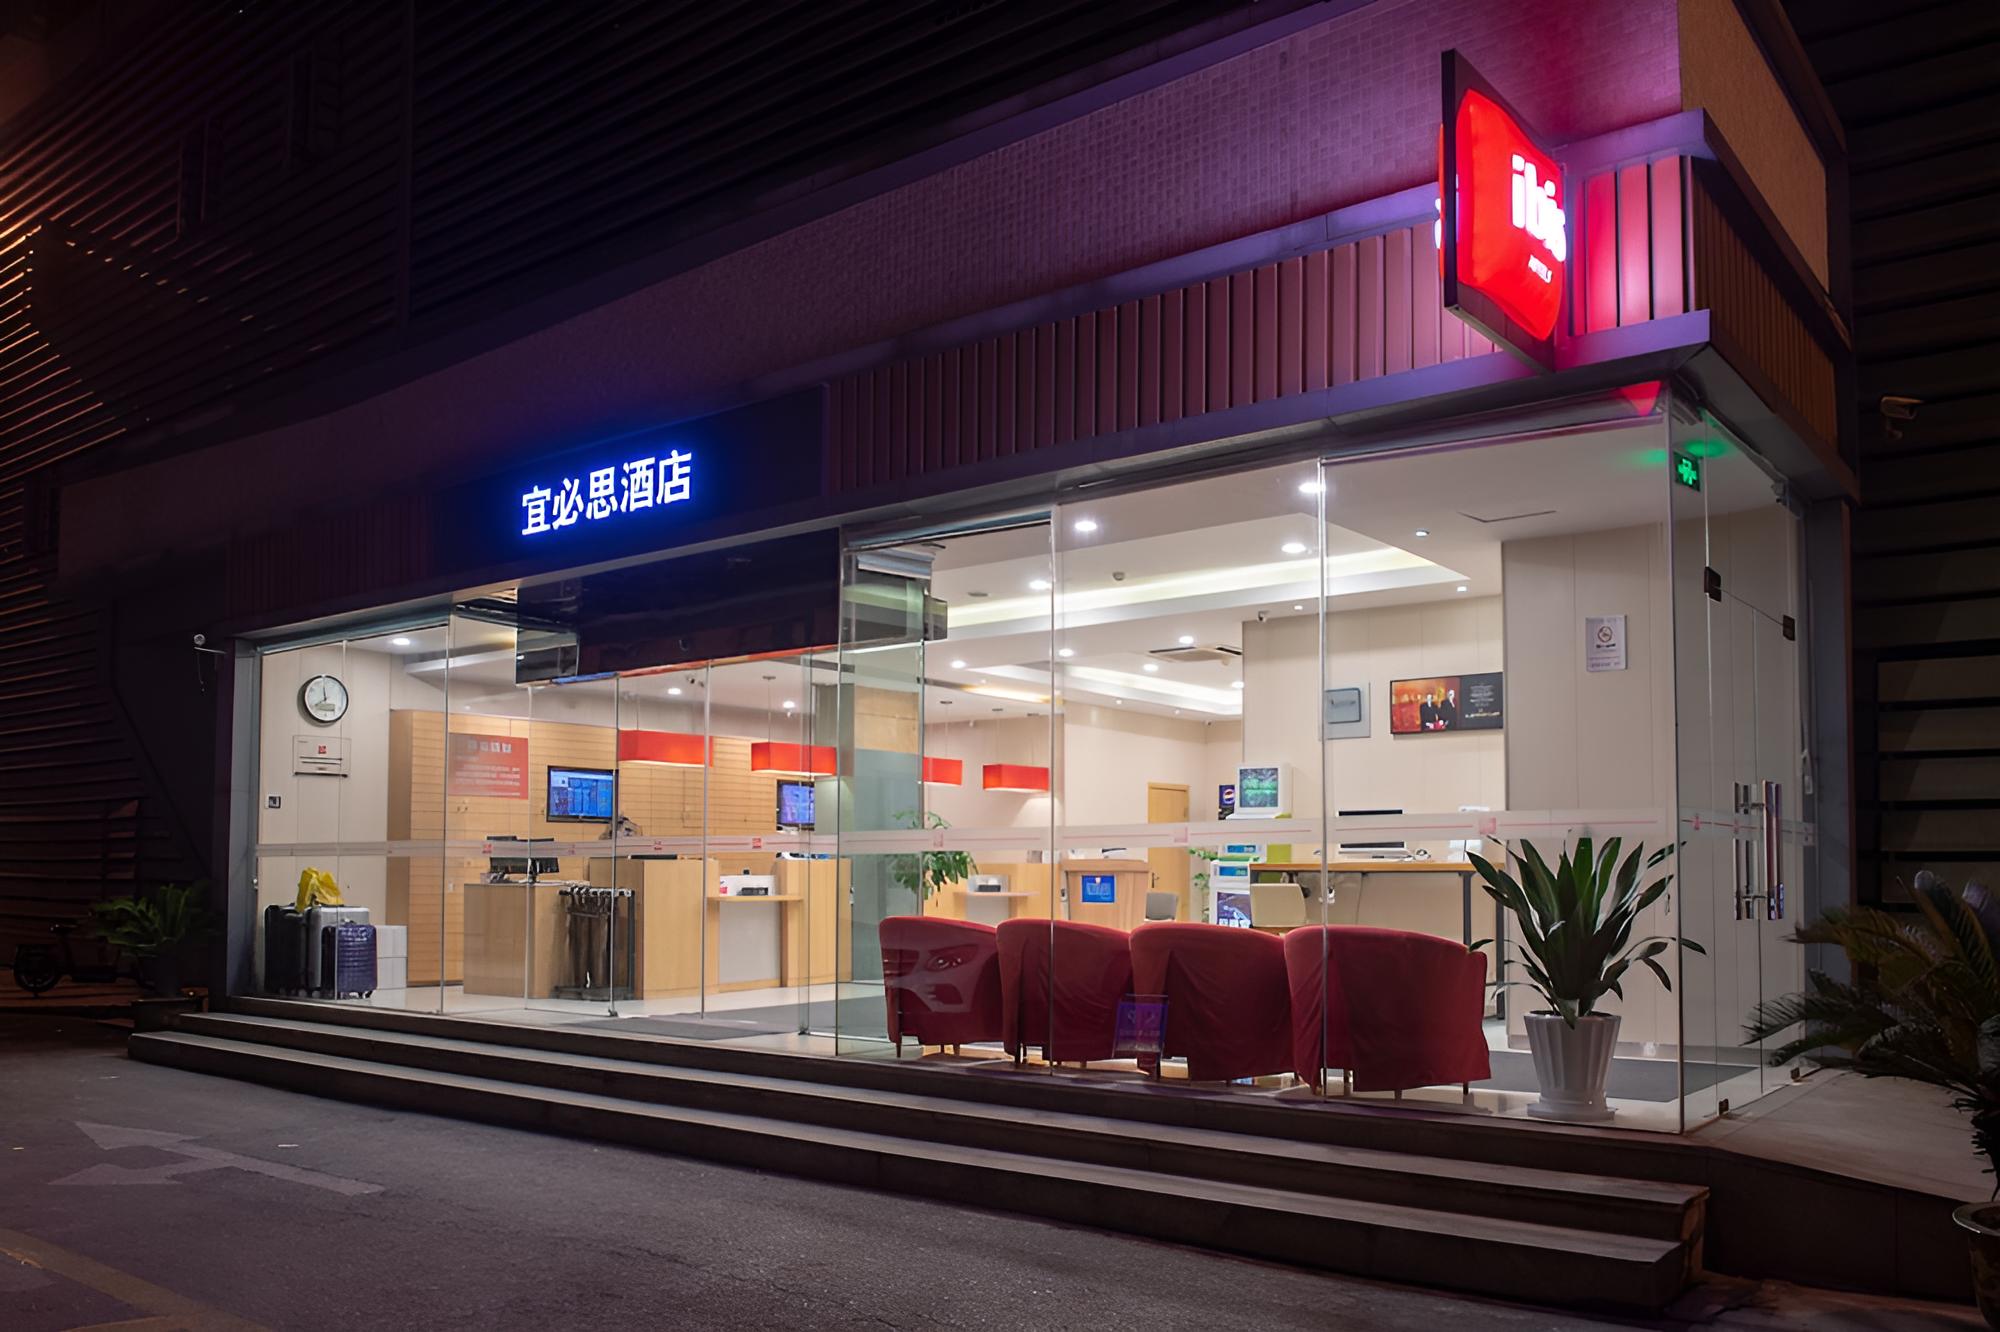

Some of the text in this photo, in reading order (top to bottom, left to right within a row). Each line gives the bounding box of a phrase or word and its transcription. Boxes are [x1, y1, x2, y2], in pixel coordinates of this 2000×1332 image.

[521, 449, 692, 535] 宜必思酒店
